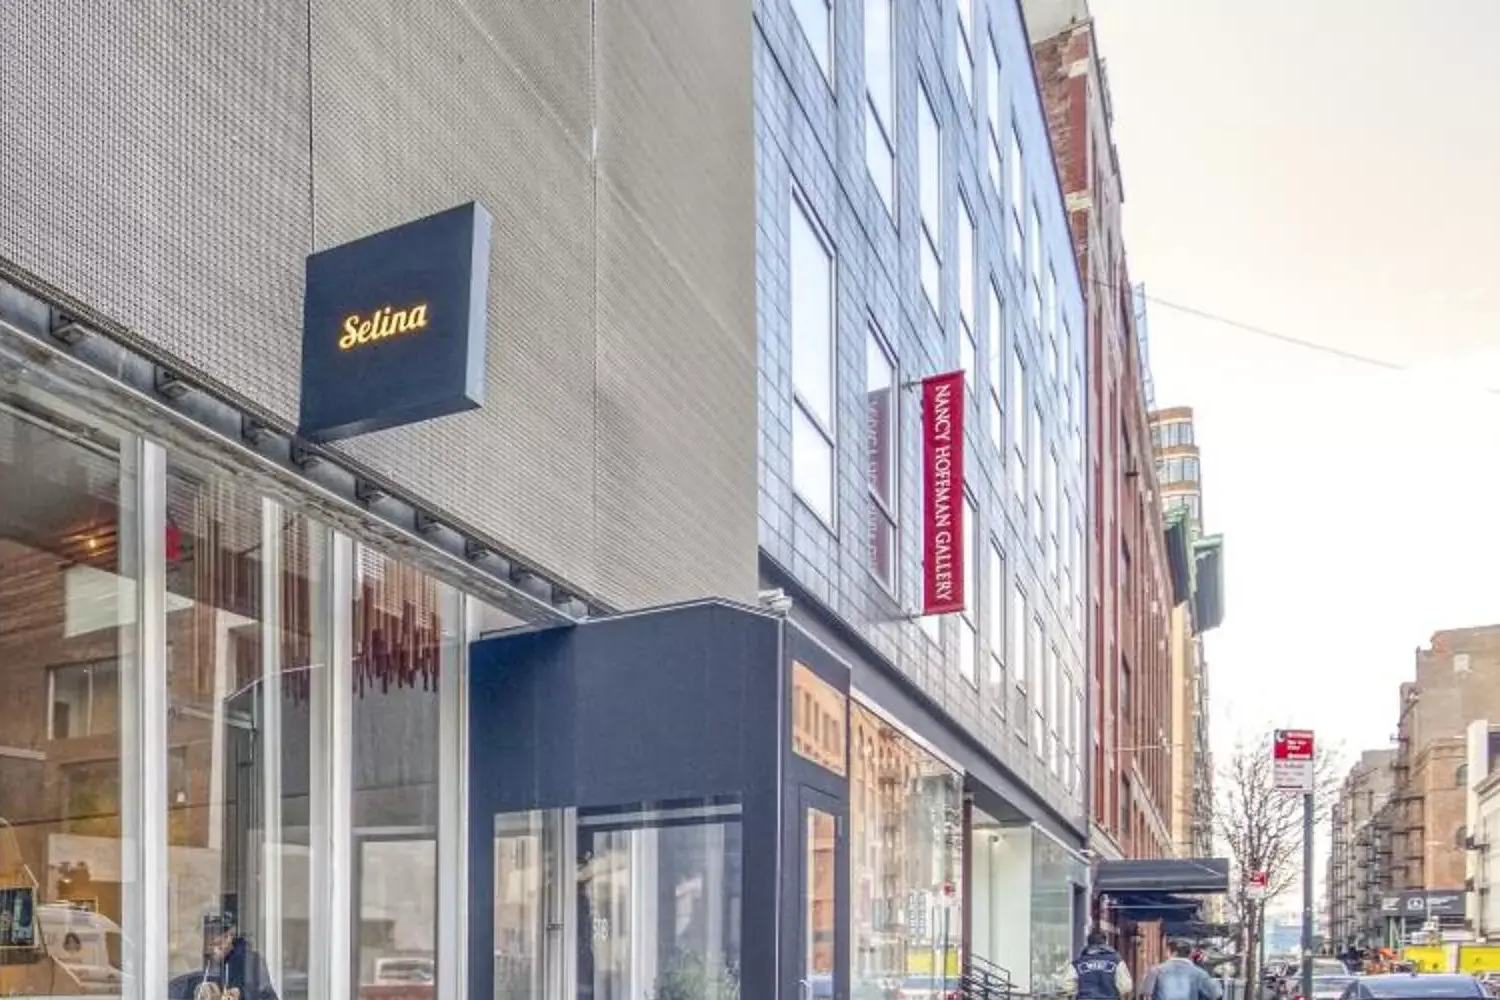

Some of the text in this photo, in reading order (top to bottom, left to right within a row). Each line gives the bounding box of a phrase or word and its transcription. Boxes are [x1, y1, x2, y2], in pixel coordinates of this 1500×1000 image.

[339, 304, 428, 349] Selina
[935, 384, 953, 601] NANCY HOFFMAN GALLERY
